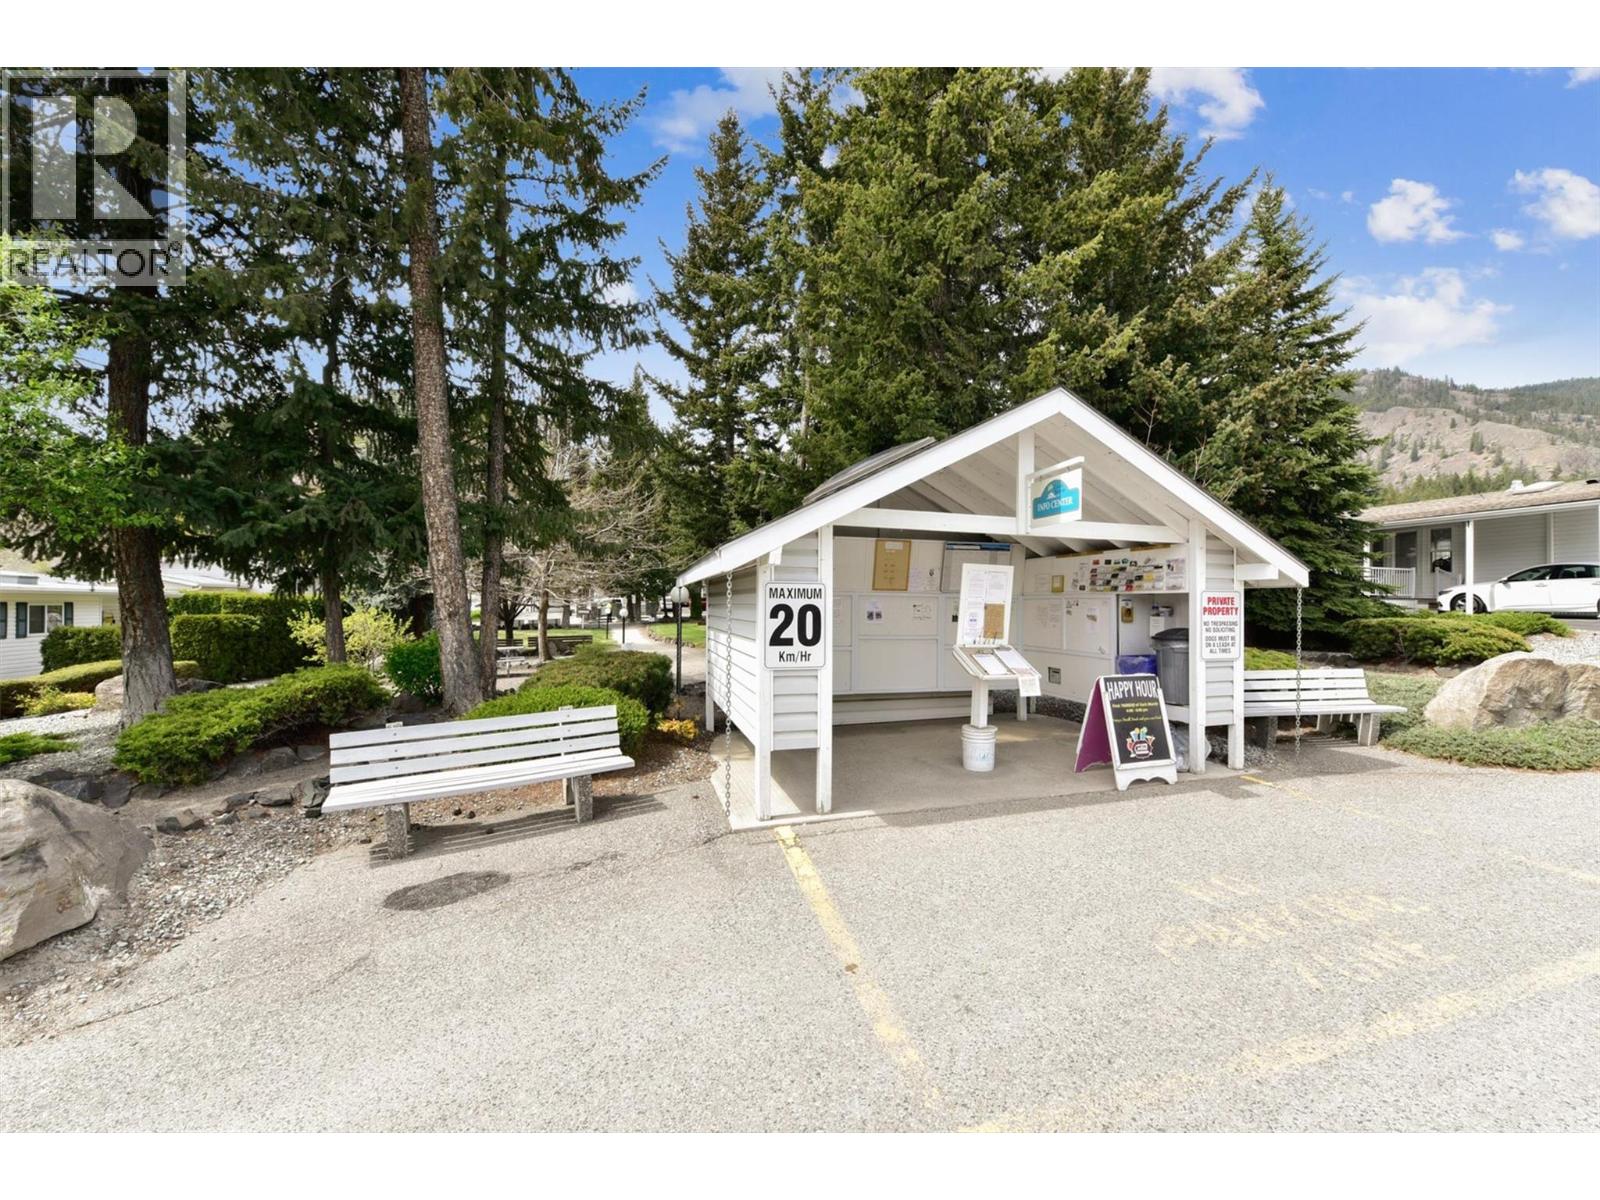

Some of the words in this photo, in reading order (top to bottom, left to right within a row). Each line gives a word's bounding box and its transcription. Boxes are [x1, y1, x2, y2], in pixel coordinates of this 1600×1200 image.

[769, 587, 822, 600] MAXIMUM
[1207, 597, 1235, 605] PRIVATE
[1203, 607, 1239, 616] PROPERTY
[769, 603, 822, 647] 20
[779, 650, 812, 663] Km/Hr
[1106, 680, 1134, 701] HAPPY
[1134, 680, 1159, 698] HOUR
